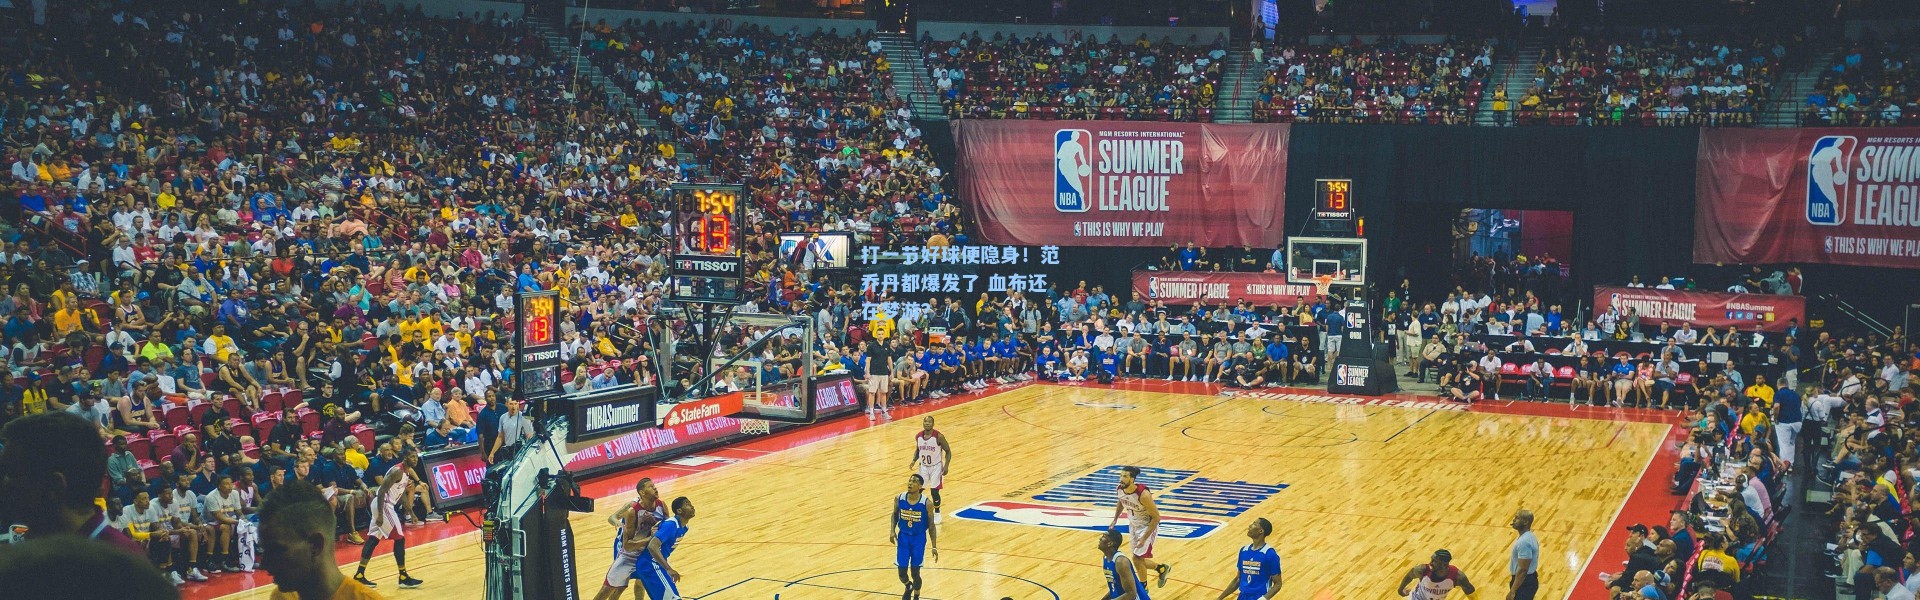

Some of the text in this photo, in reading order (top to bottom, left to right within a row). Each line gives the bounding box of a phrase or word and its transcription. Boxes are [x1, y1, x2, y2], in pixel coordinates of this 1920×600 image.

[1099, 139, 1183, 174] SUMMER
[1098, 175, 1170, 211] LEAGUE
[1327, 181, 1348, 192] 7:54
[694, 190, 736, 214] 7:54
[1059, 192, 1077, 206] NBA
[1329, 193, 1344, 209] 13
[1811, 202, 1830, 218] NBA
[699, 215, 730, 253] 13
[1082, 222, 1164, 237] THIS IS WHY WE PLAY
[1834, 236, 1855, 253] THIS
[1856, 237, 1866, 254] IS
[1868, 238, 1889, 255] WHY
[1890, 239, 1904, 256] WE
[692, 260, 737, 272] TISSOT
[1160, 282, 1198, 298] SUMMER
[1252, 284, 1310, 296] THIS IS WHY WE PLAY
[1622, 300, 1697, 320] SUMMER LEAGUE
[1726, 303, 1774, 311] #NBASummer
[534, 318, 548, 341] 13
[534, 350, 559, 361] TISSOT
[1365, 398, 1472, 411] LEAGUE
[586, 403, 640, 431] #NBASummer
[922, 455, 931, 465] 20
[443, 470, 458, 490] TV
[907, 520, 913, 528] 6
[562, 549, 571, 583] RESORTS
